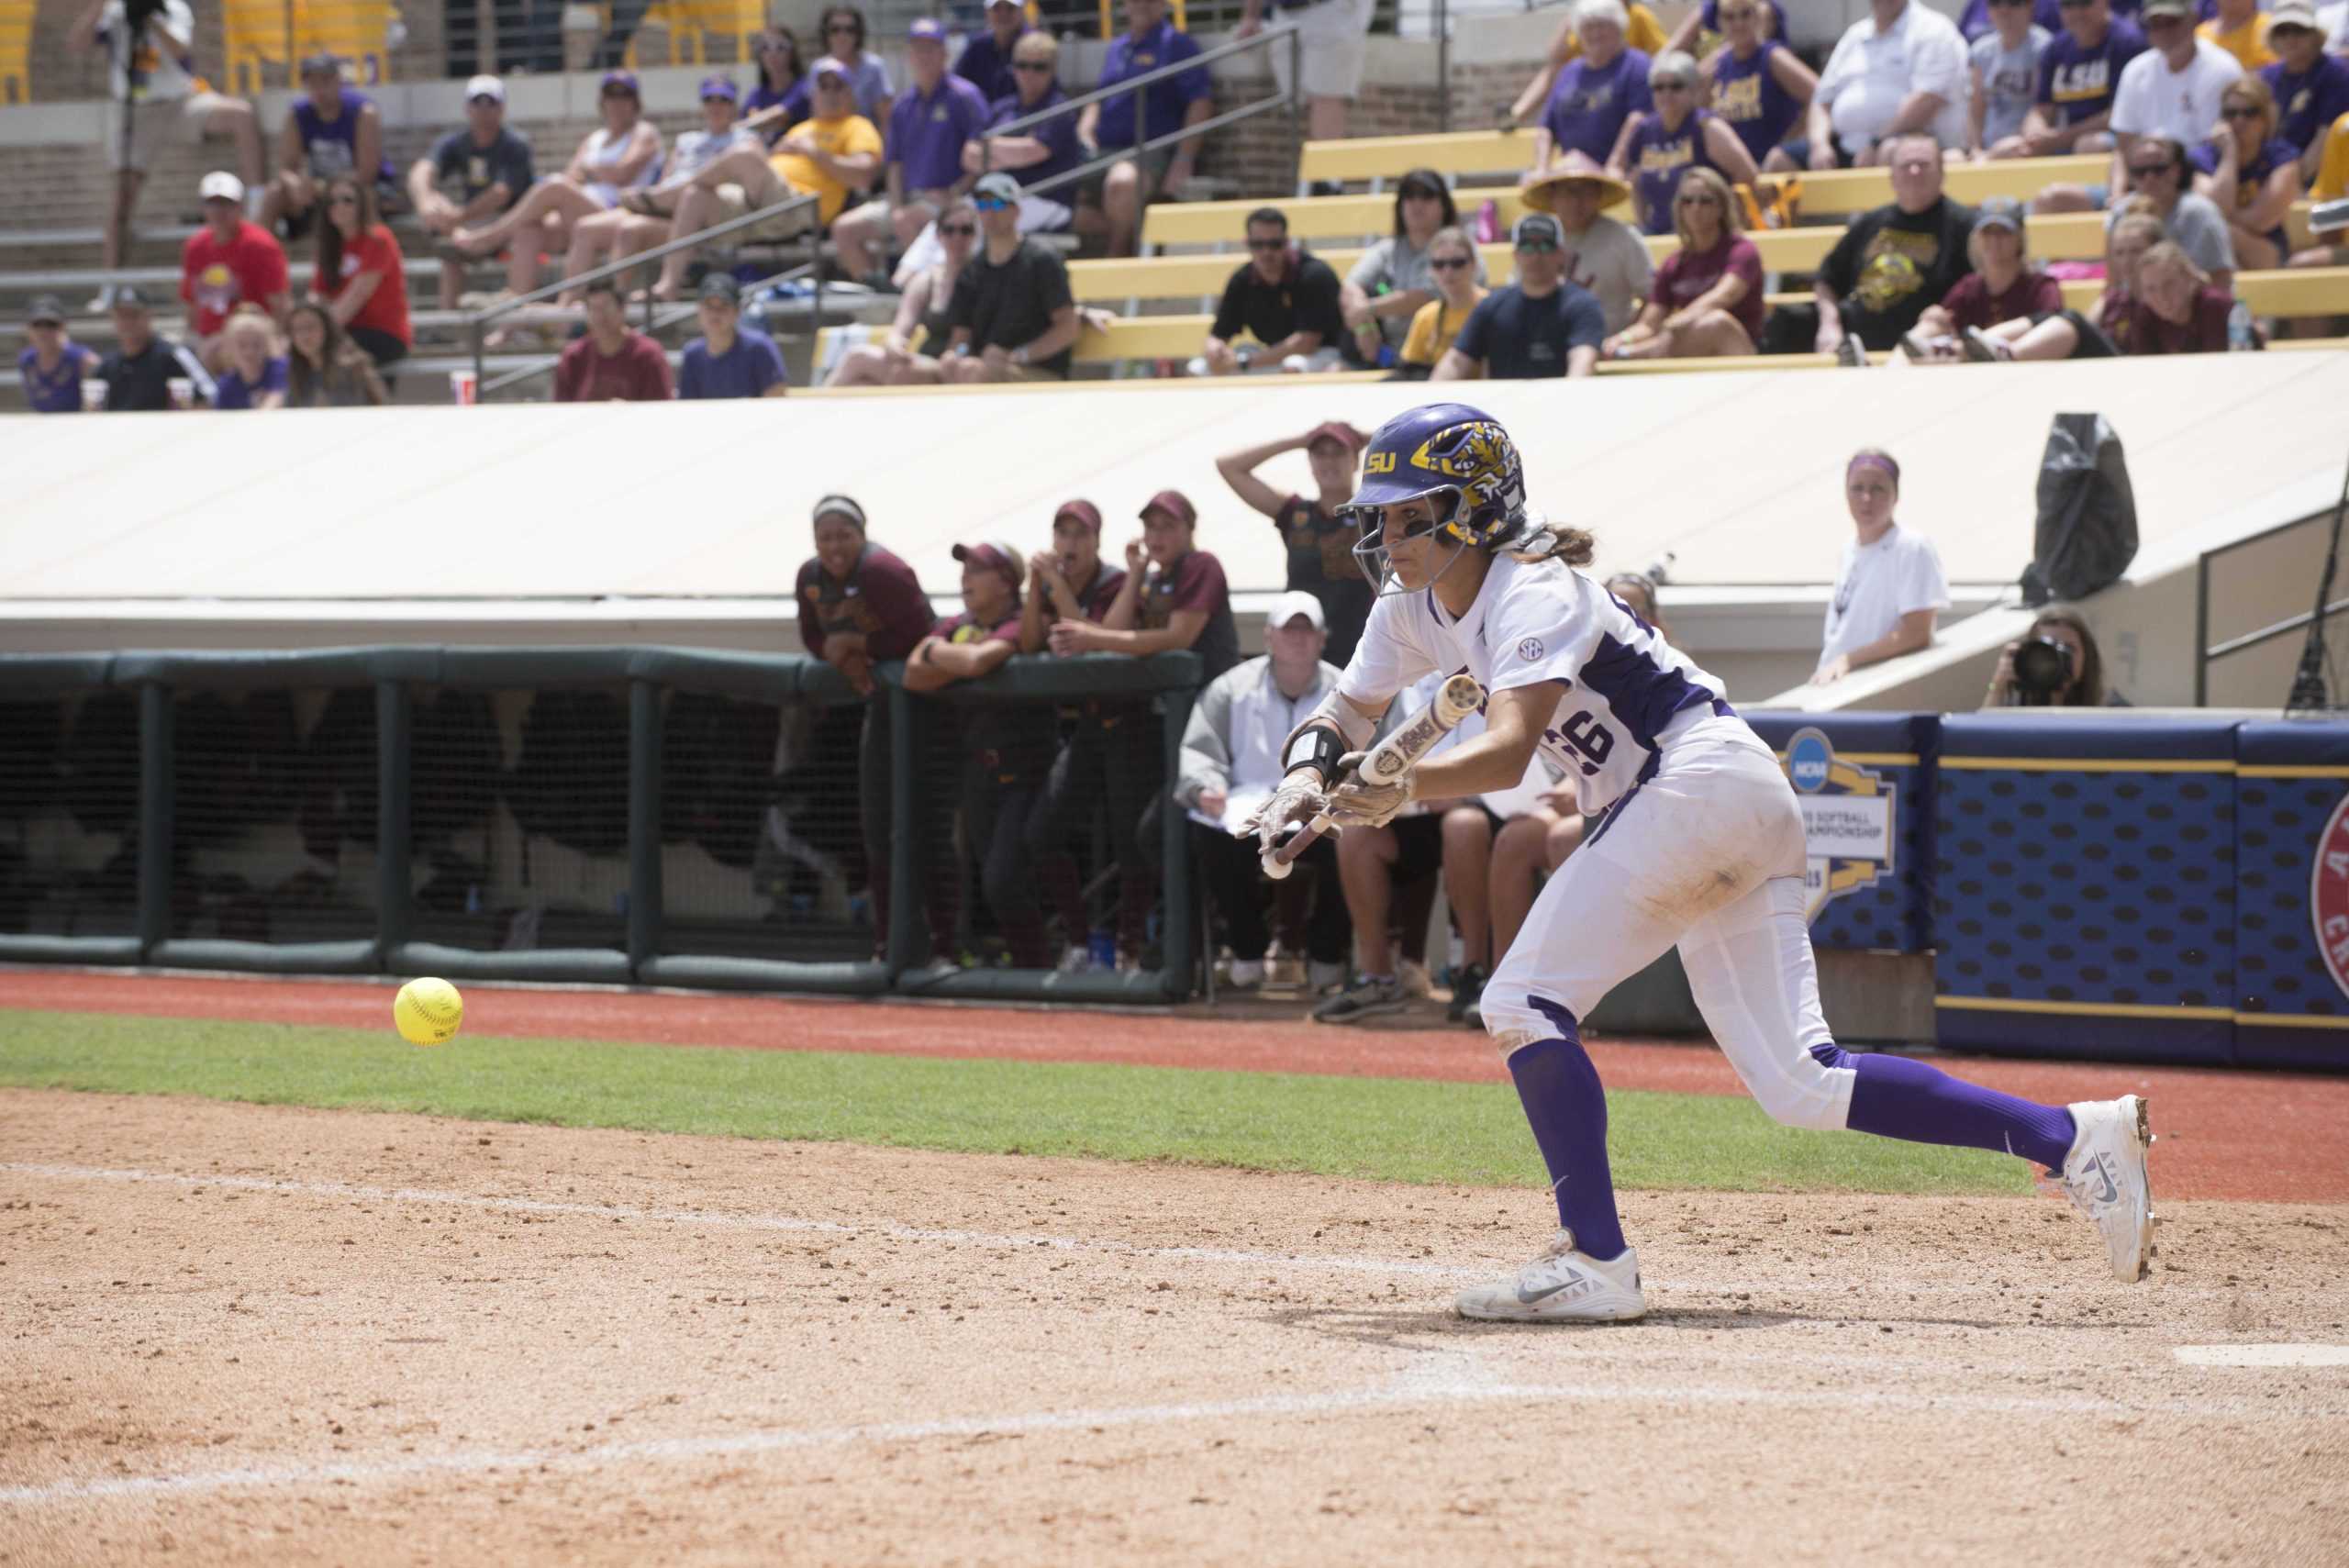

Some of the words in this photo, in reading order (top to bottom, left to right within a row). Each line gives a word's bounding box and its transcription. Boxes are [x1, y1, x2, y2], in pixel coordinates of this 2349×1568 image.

[1364, 452, 1396, 474] LSU
[1520, 639, 1543, 660] SEC
[1806, 825, 1882, 840] AMPIONSHIP
[1806, 869, 1822, 888] 15
